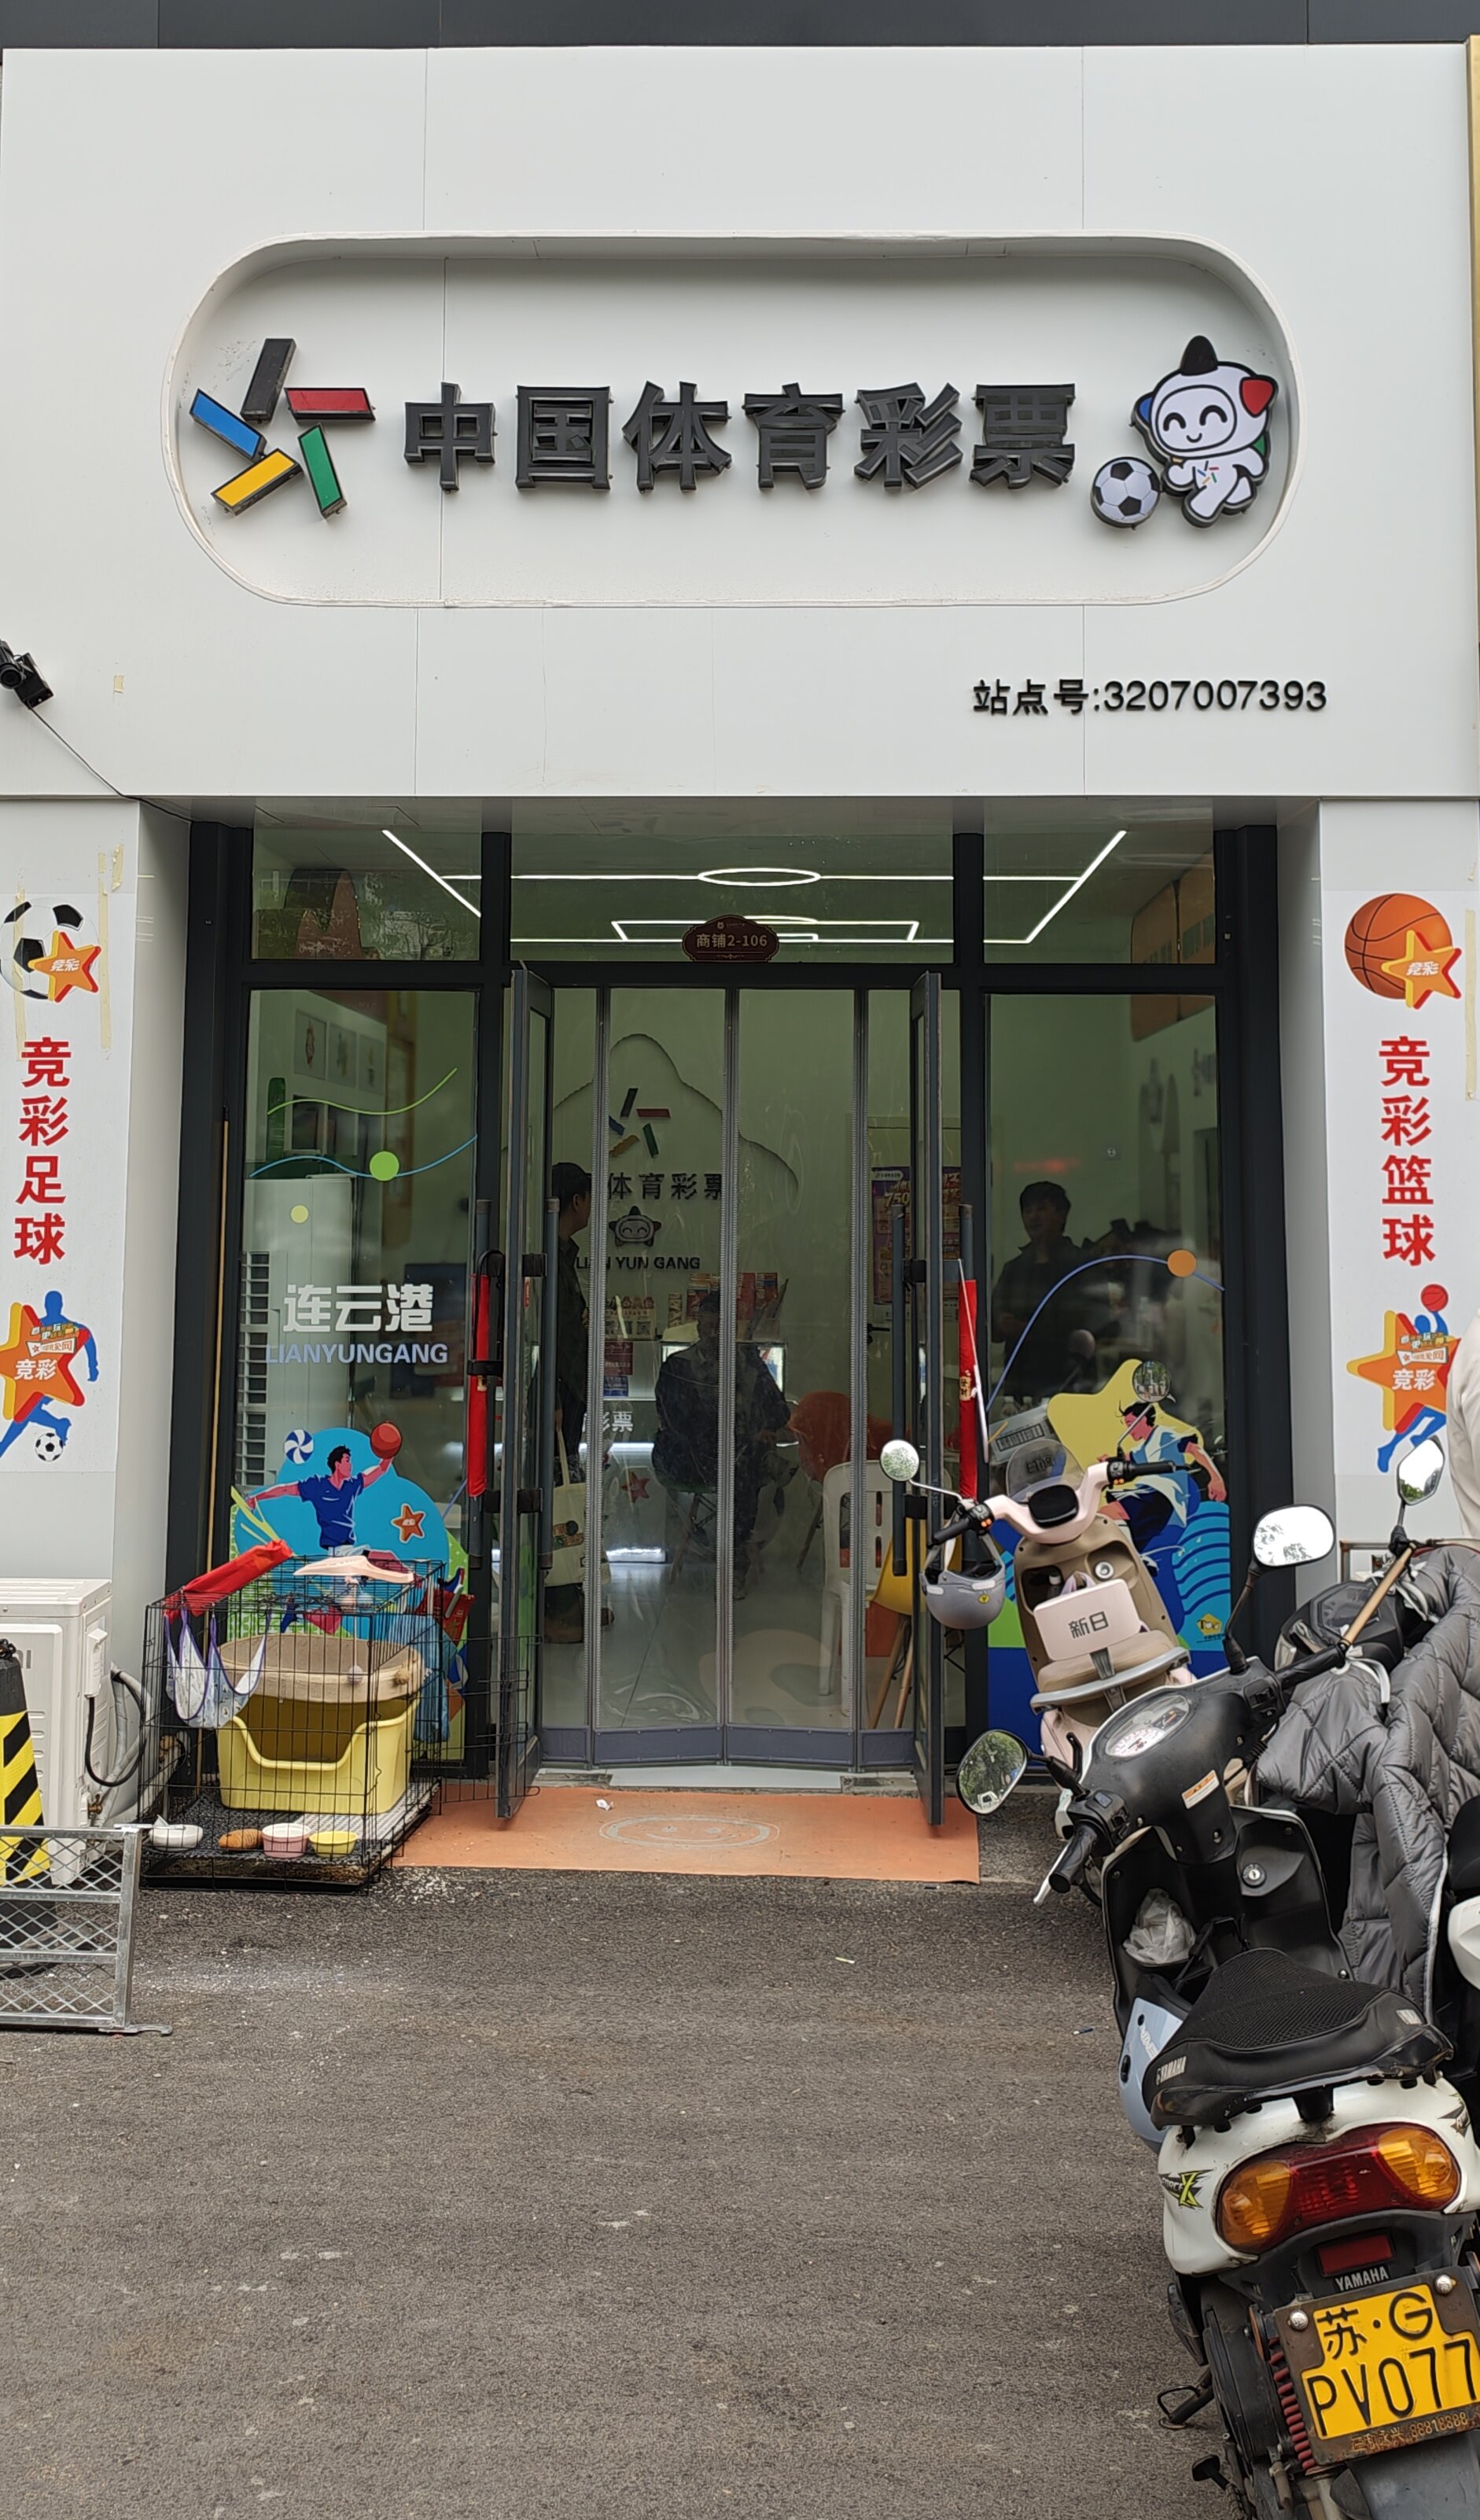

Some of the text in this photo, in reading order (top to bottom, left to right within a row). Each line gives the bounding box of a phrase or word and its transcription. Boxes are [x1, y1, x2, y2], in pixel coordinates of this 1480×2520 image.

[403, 381, 1076, 493] 中国体育彩票
[973, 679, 1327, 716] 站点号:3207007393
[696, 934, 768, 948] 商铺2-106
[13, 1037, 72, 1266] 竞彩足球
[1379, 1036, 1436, 1267] 竞彩篮球
[616, 1256, 649, 1269] YUN
[653, 1256, 701, 1269] GANG
[283, 1284, 434, 1332] 连云港
[265, 1343, 449, 1365] LIANYUNGANG
[14, 1359, 57, 1380] 竞彩
[1391, 1369, 1435, 1391] 竞彩
[1068, 1611, 1110, 1639] 新日
[1335, 2266, 1390, 2291] YAMAHA
[1306, 2338, 1478, 2437] PV077
